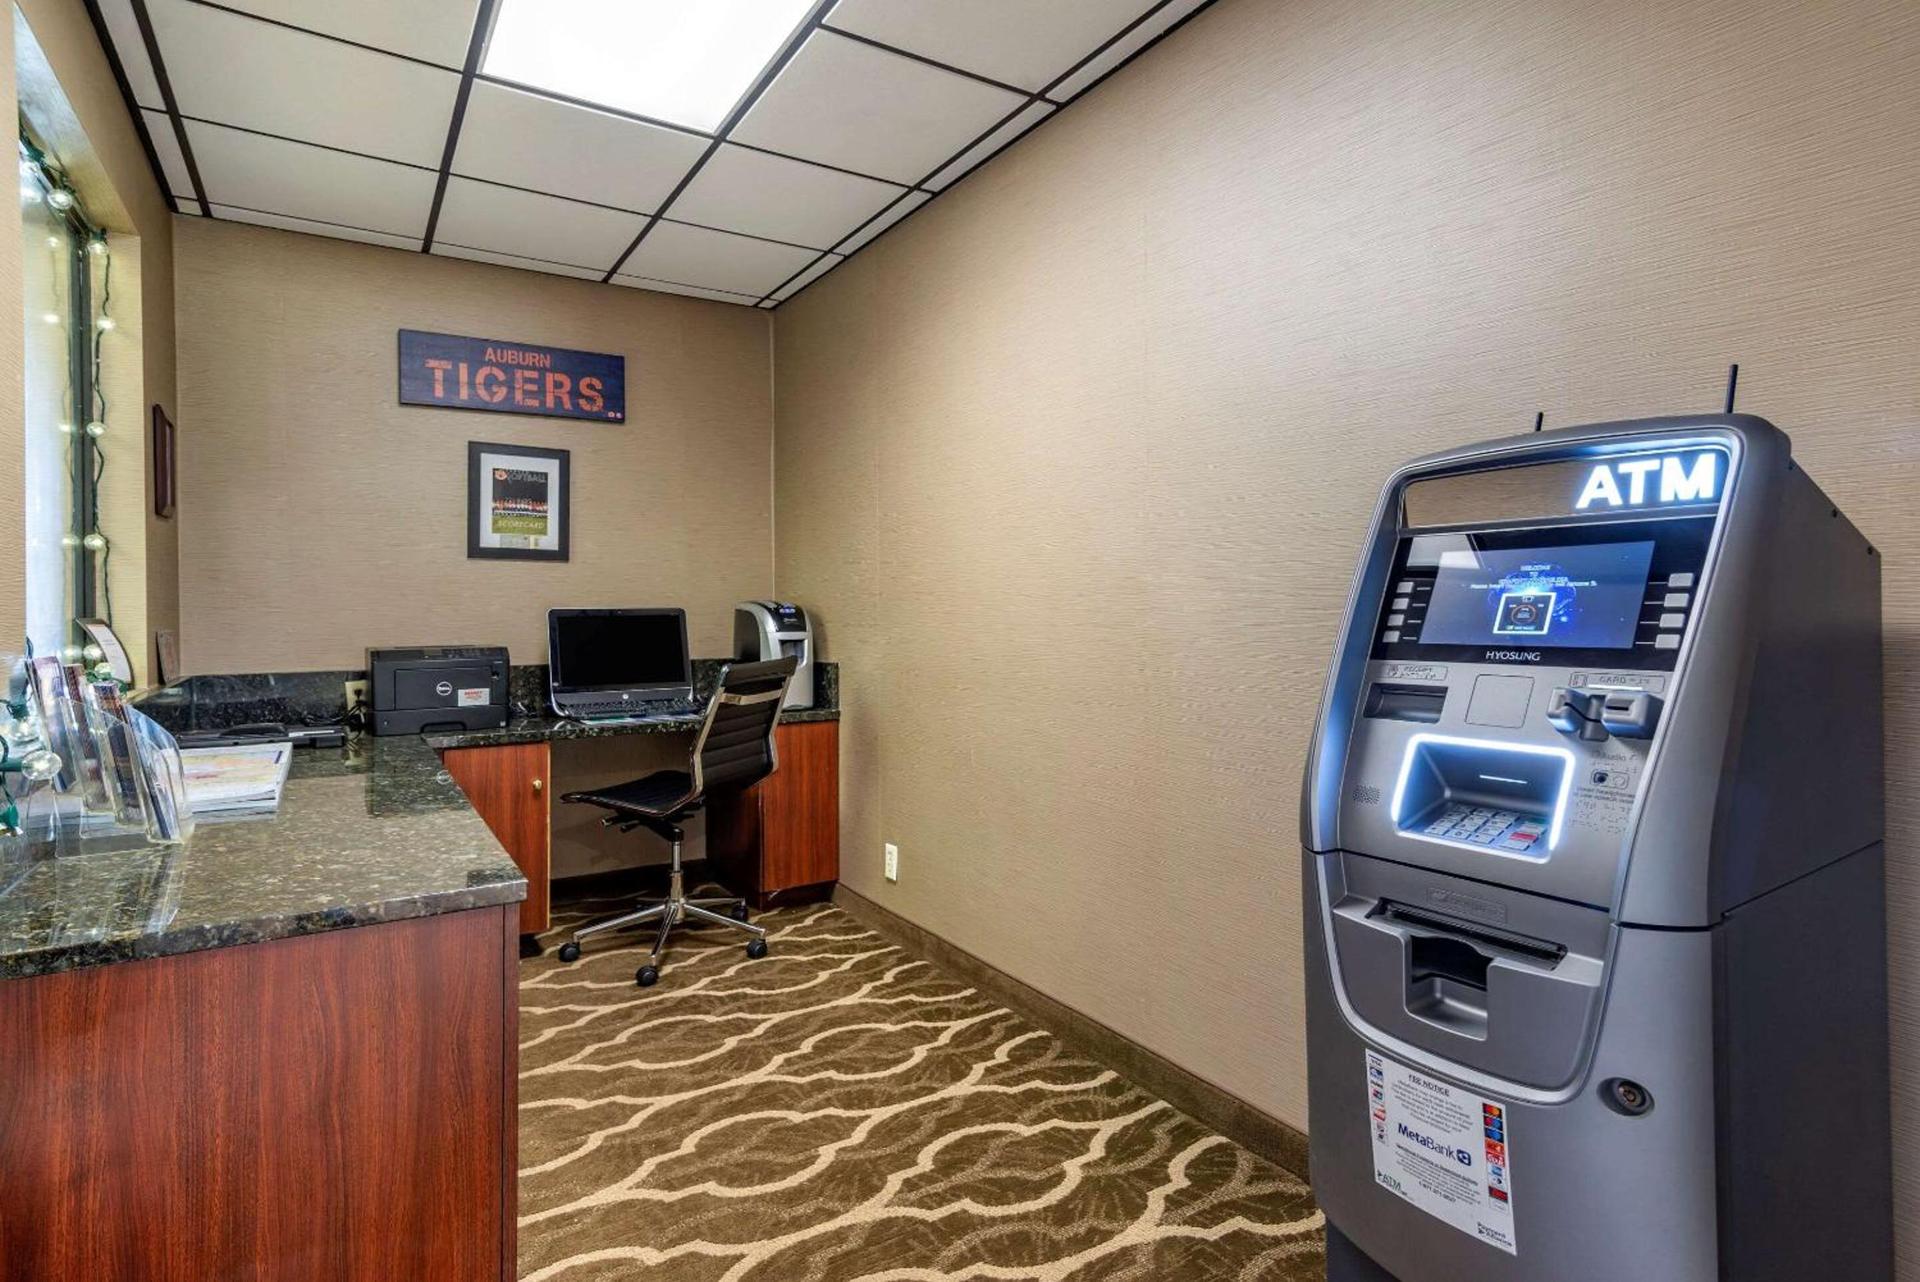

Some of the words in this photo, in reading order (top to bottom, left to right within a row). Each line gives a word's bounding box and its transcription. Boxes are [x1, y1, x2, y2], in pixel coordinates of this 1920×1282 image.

[484, 347, 551, 368] AUBURN
[424, 359, 604, 413] TIGERS
[1575, 452, 1717, 509] ATM
[1485, 651, 1542, 662] HYOSUNG
[1398, 1122, 1456, 1160] MetaBank
